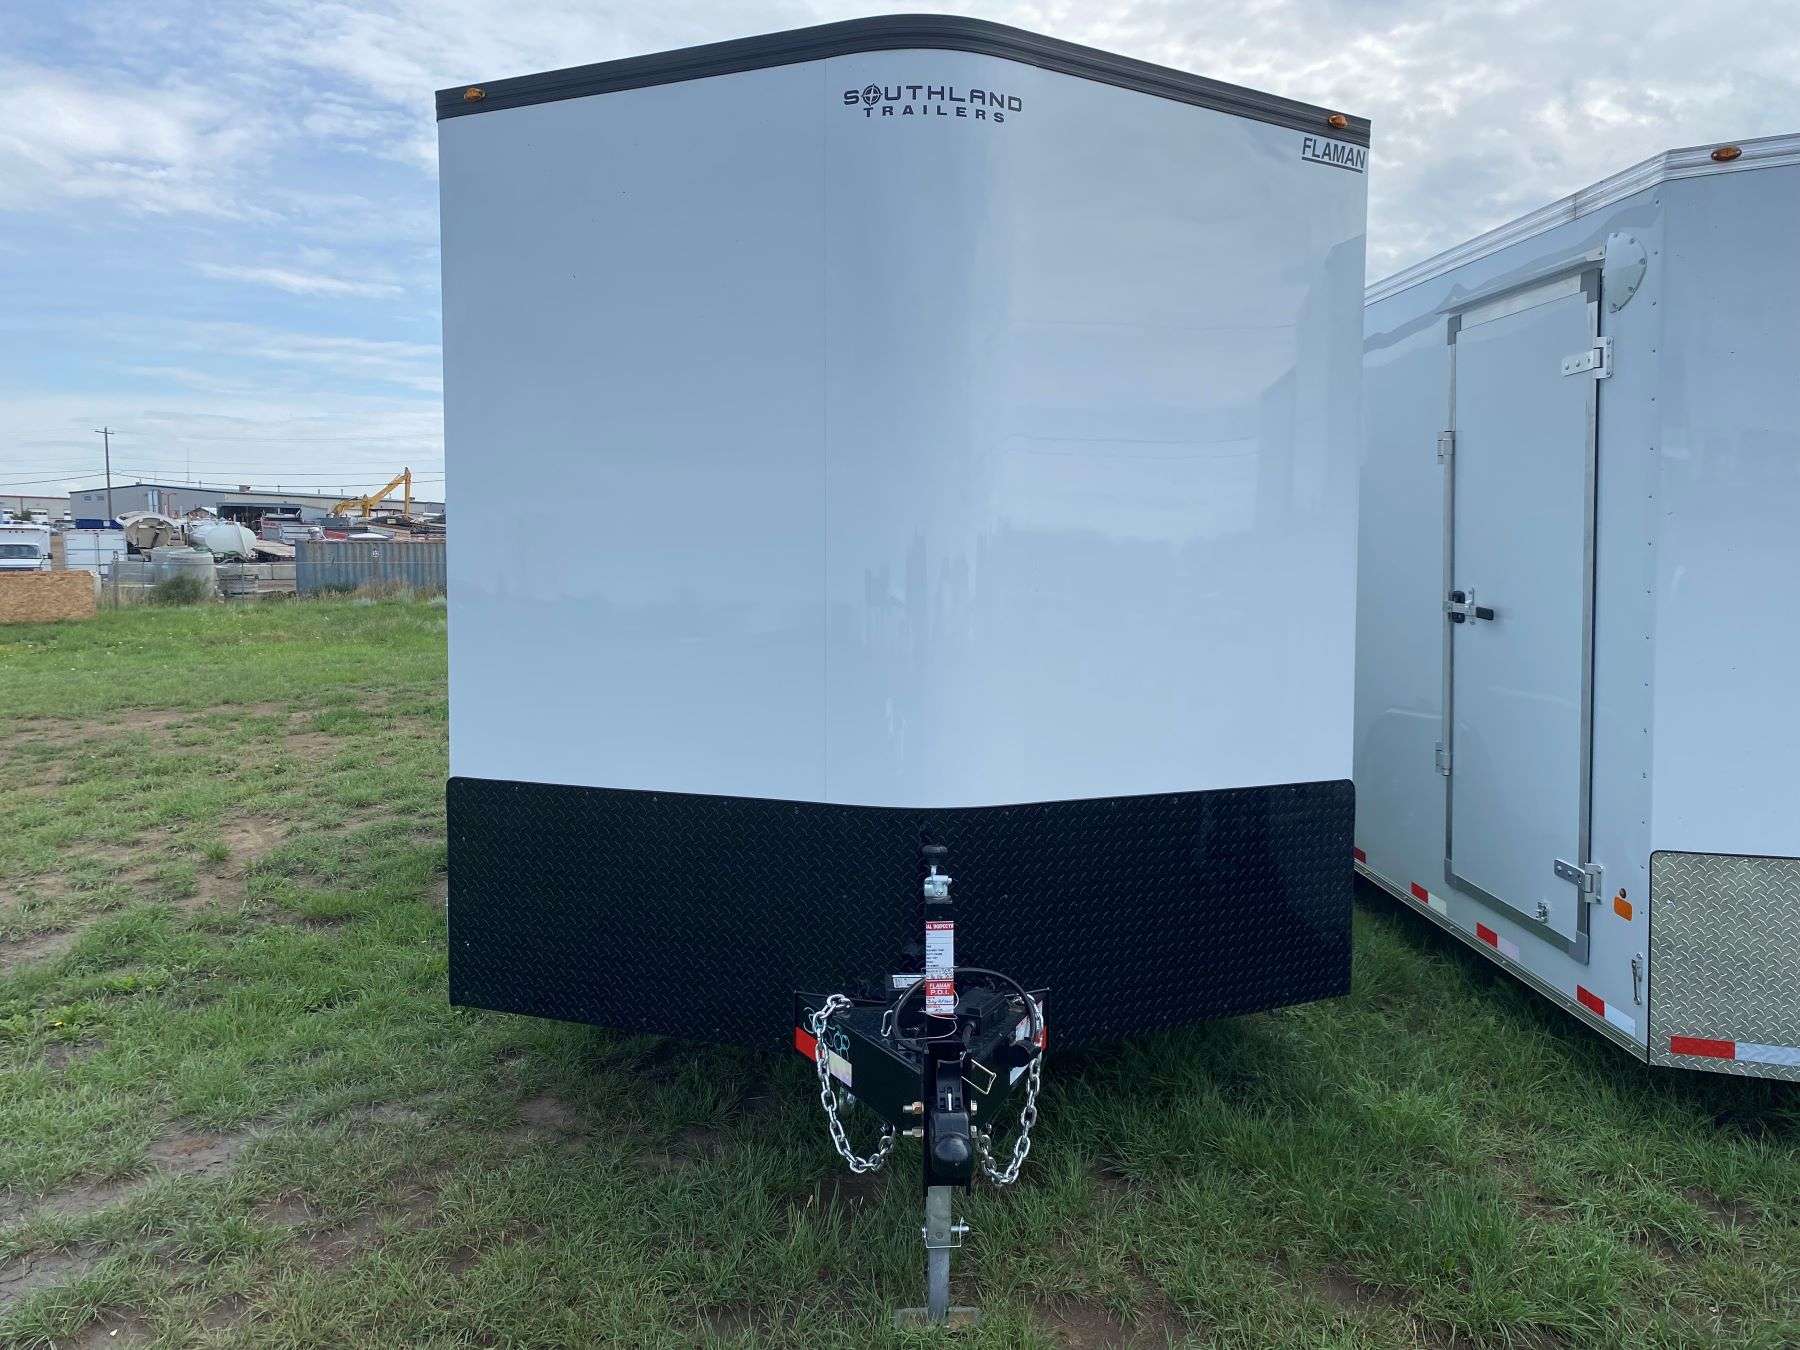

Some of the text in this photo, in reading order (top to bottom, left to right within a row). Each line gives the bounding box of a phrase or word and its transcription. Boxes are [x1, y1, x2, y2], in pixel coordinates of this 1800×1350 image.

[844, 83, 1022, 112] SOUTHLAND
[863, 104, 1005, 123] TRAILERS
[1302, 136, 1366, 169] FLAMAN
